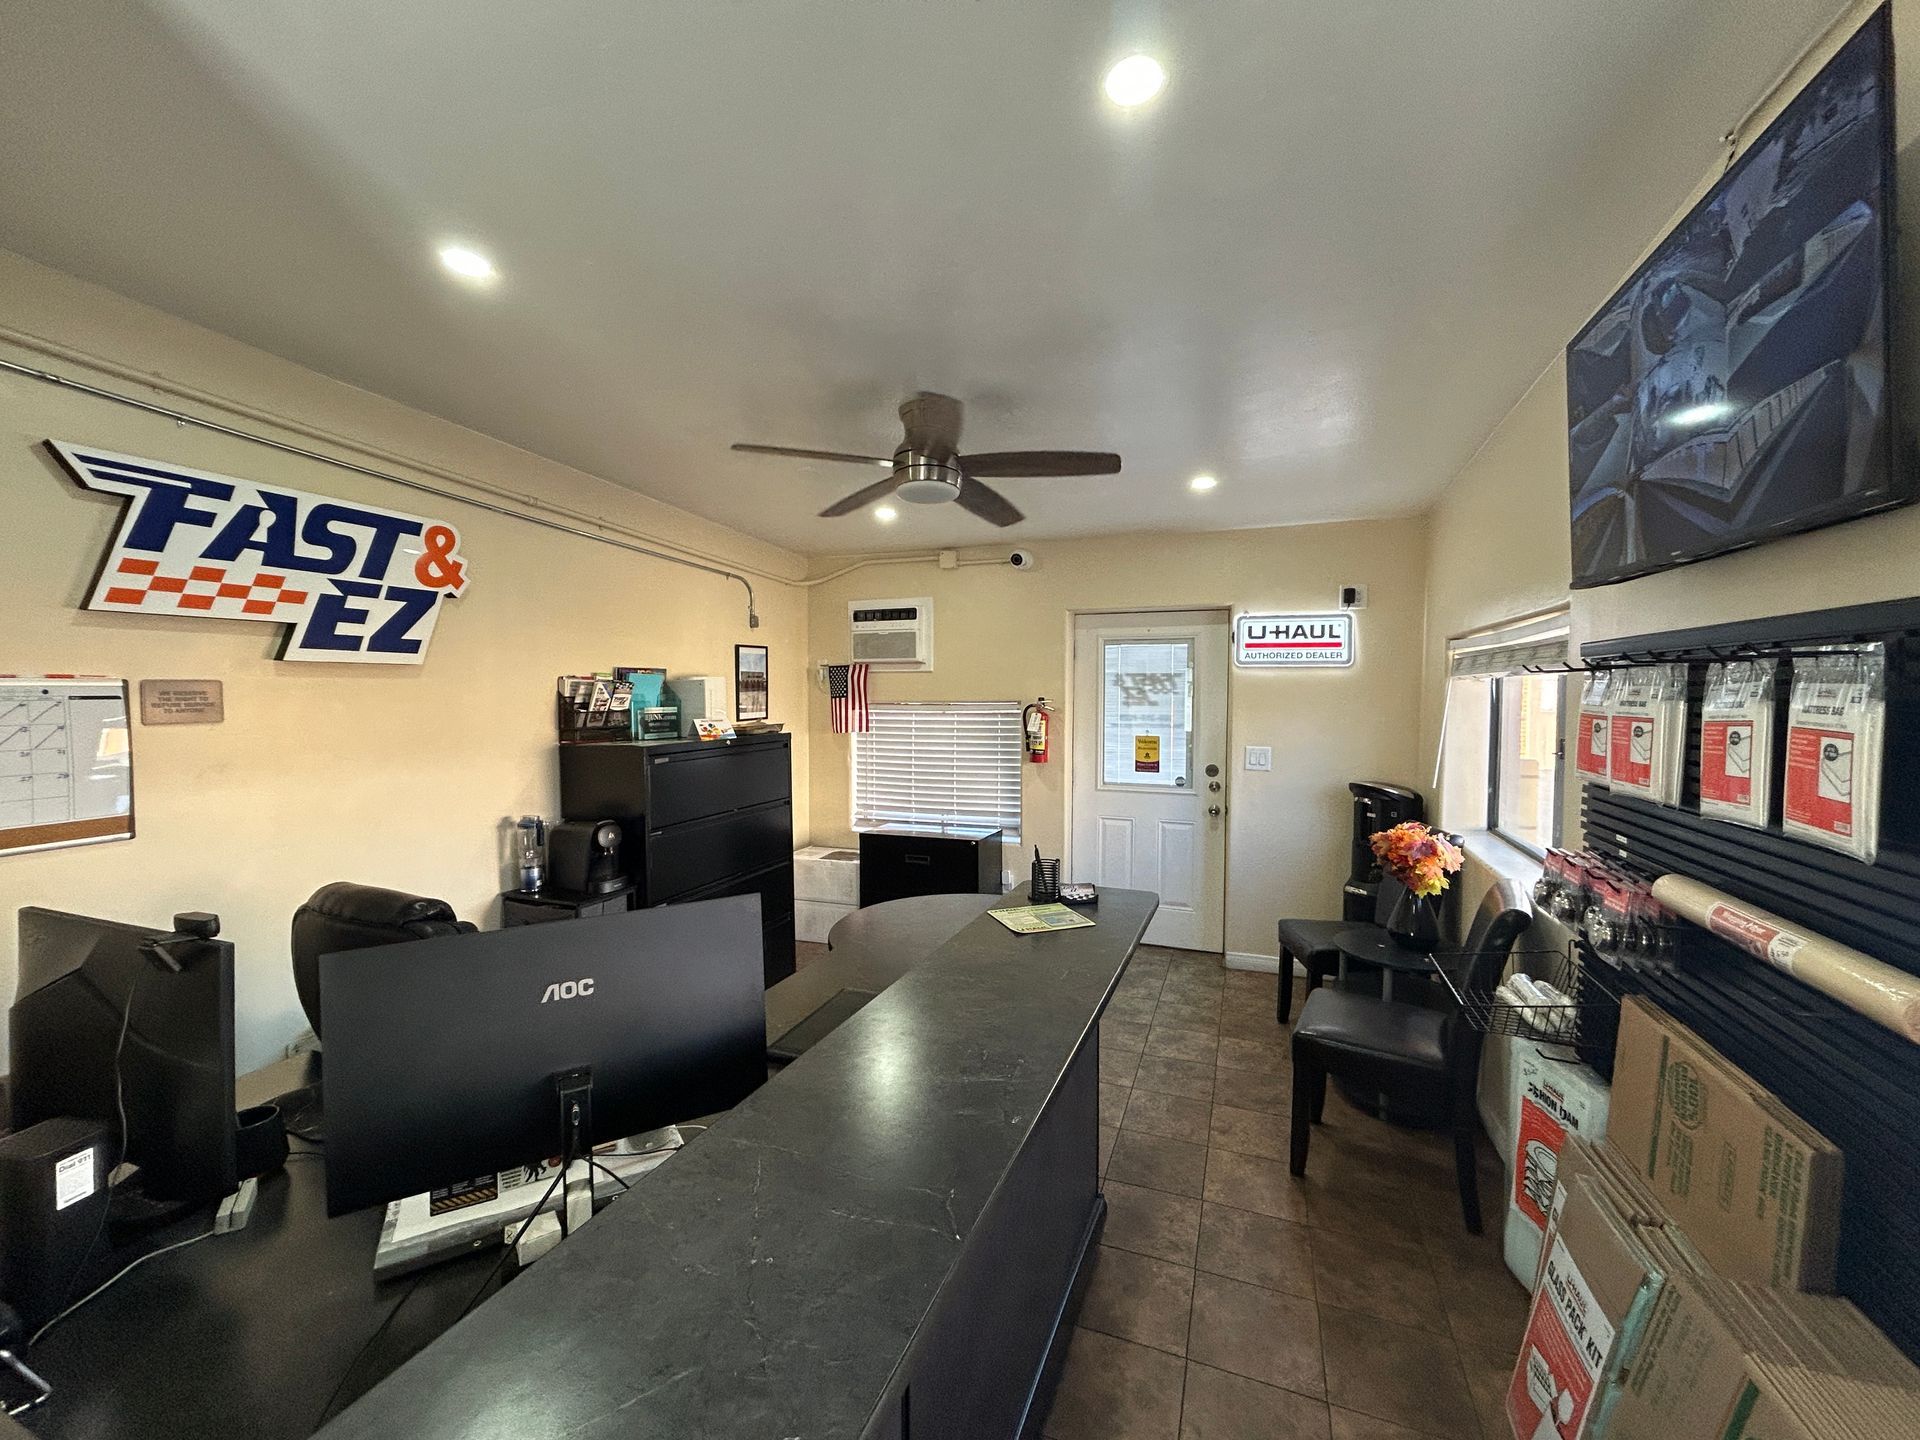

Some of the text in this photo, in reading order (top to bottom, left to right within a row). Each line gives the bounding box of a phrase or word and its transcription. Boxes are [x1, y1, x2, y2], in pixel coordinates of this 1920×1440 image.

[72, 452, 466, 590] FAST &
[299, 578, 439, 654] EZ
[1247, 625, 1341, 639] U-HAUL
[1245, 651, 1343, 660] AUTHORIZED DEALER
[540, 978, 594, 1004] AOC
[1548, 1260, 1603, 1369] GLASS PACK KIT
